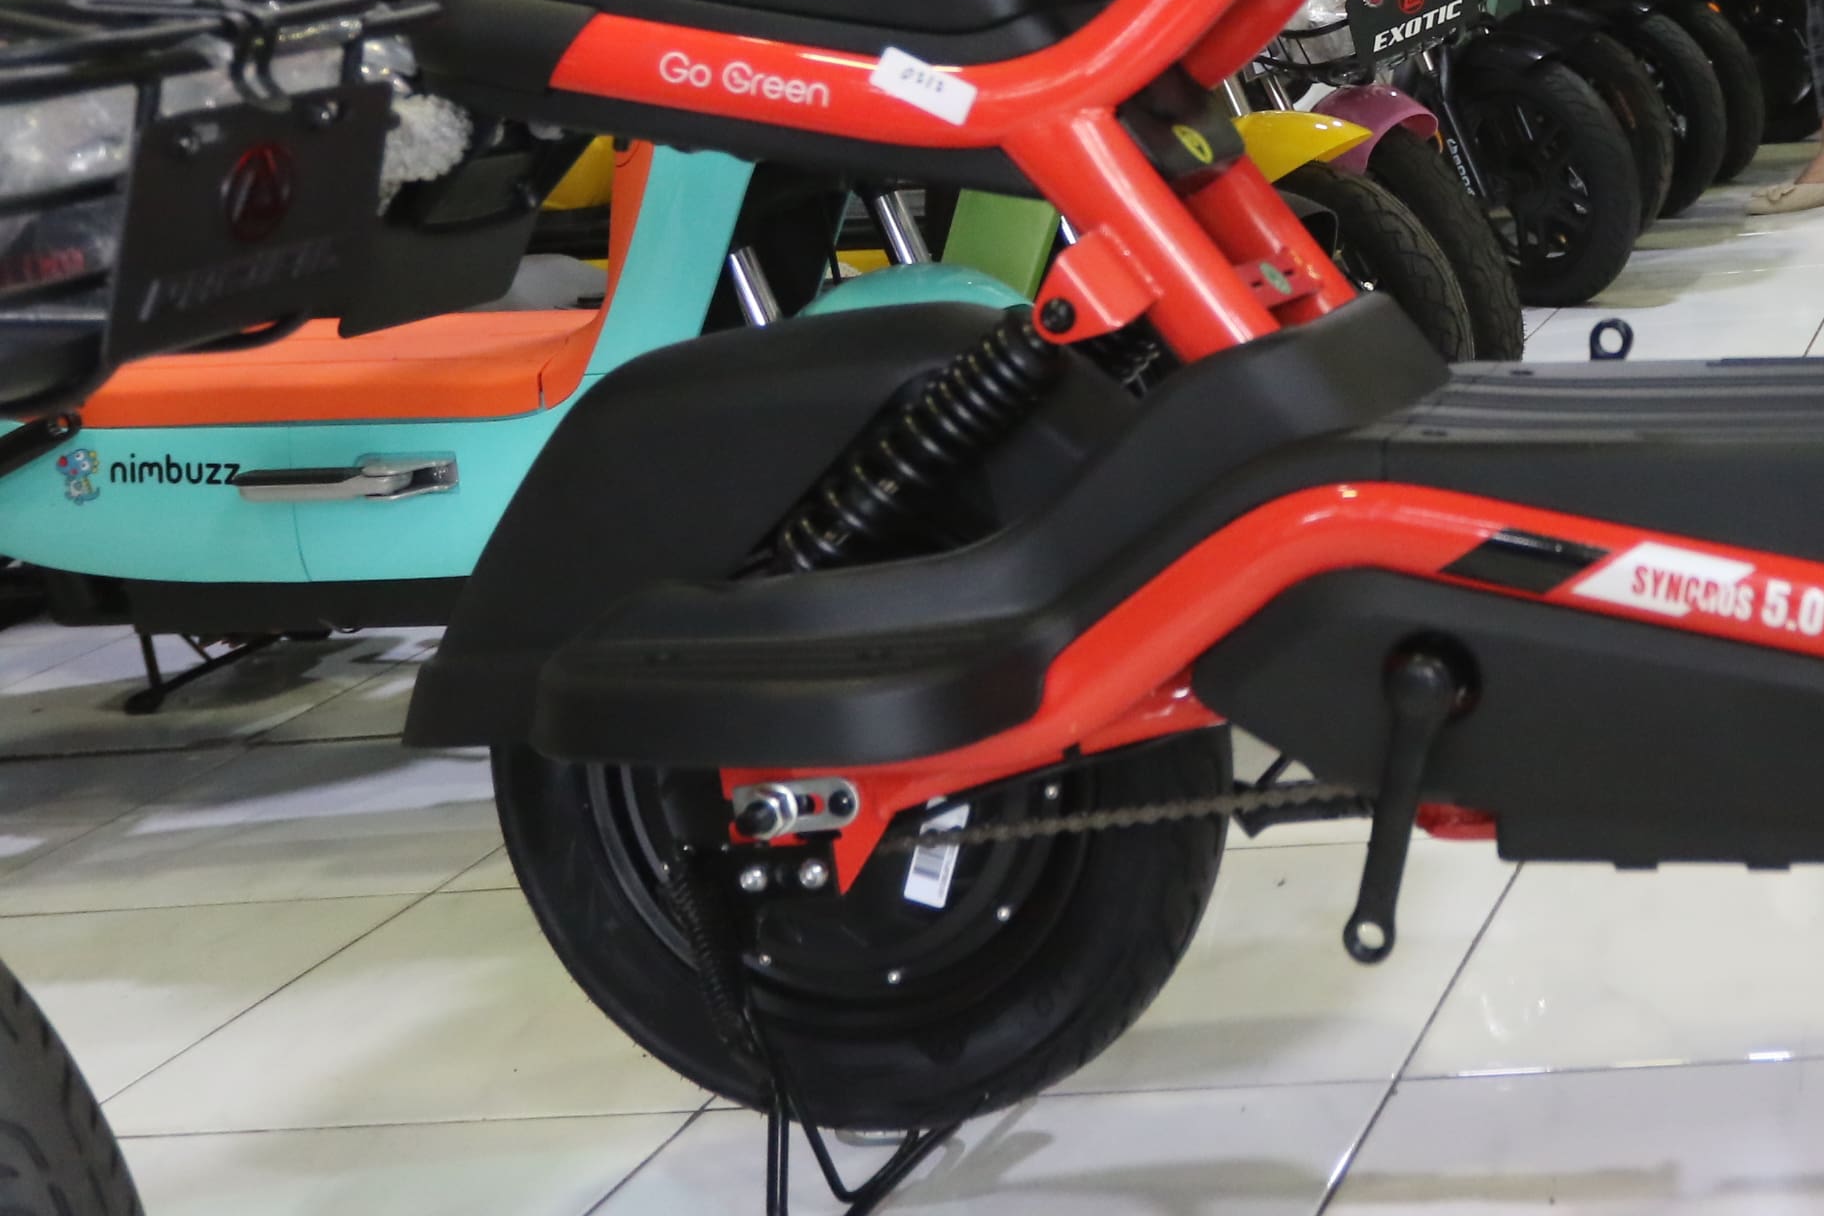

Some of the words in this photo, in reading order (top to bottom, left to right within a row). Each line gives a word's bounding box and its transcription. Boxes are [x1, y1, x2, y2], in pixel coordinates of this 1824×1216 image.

[659, 51, 712, 88] Go
[722, 61, 830, 108] Green
[110, 453, 241, 485] nimbuzz
[1631, 565, 1756, 622] SYNCROS
